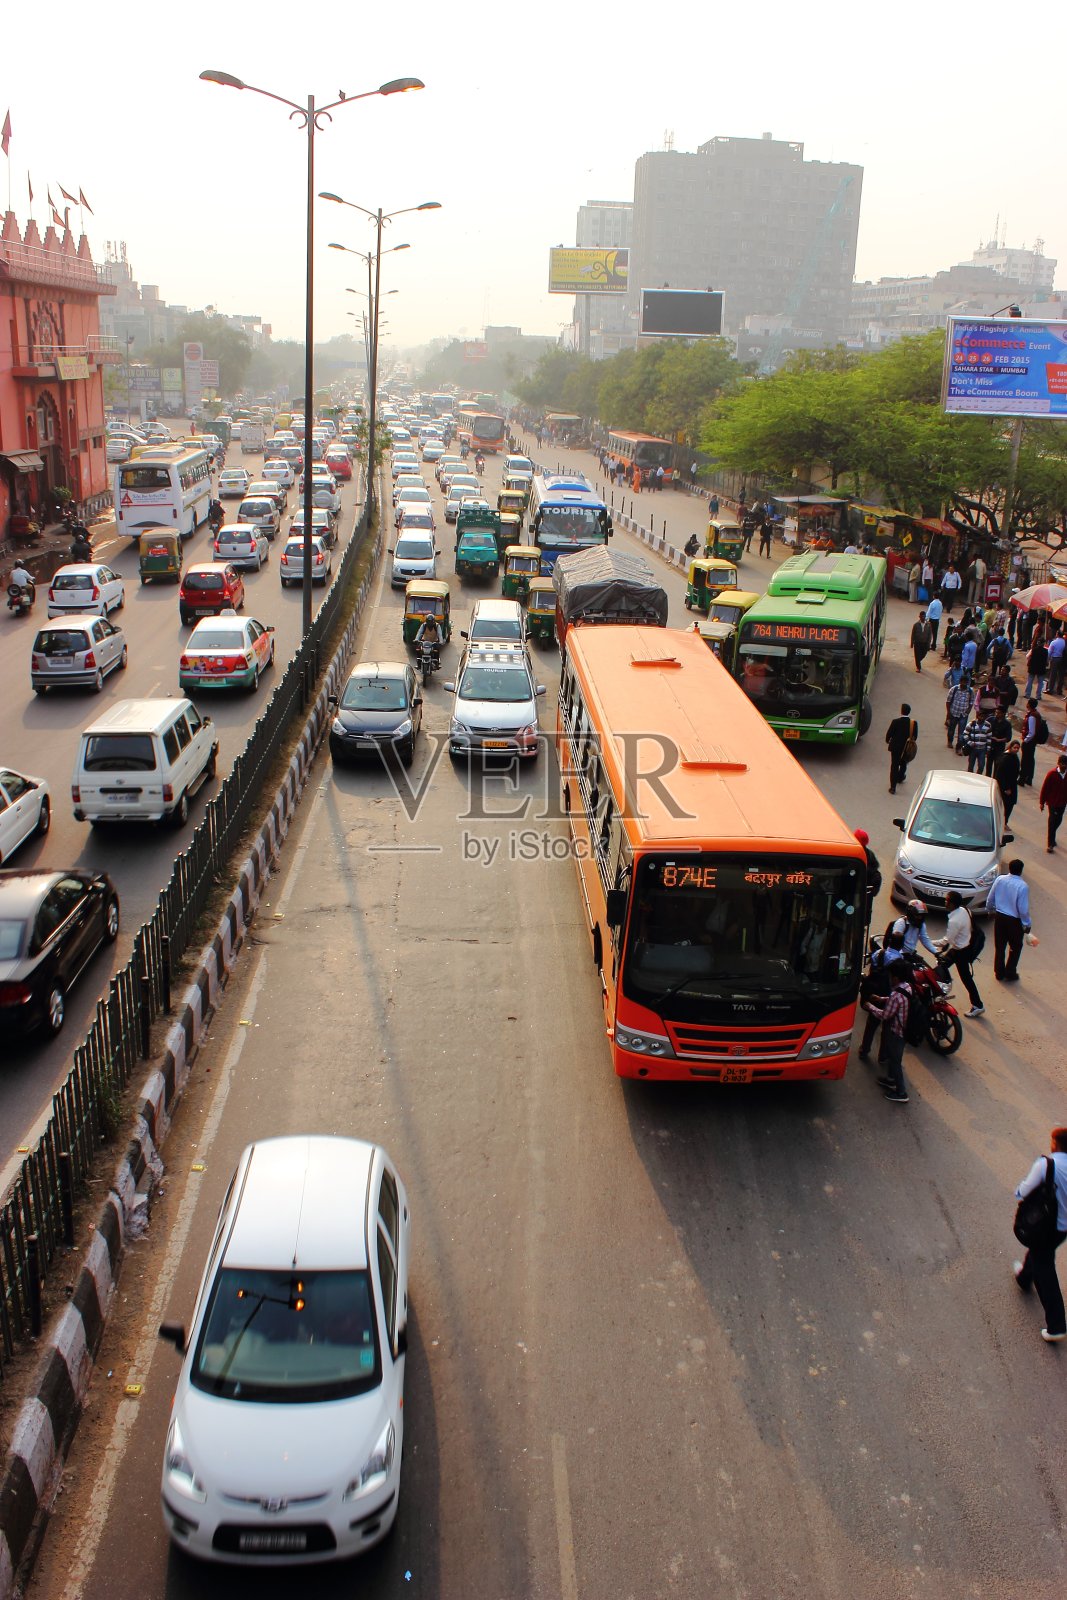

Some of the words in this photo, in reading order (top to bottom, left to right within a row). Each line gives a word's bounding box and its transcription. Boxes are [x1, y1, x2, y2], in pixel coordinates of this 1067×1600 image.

[955, 323, 978, 332] India's
[979, 324, 1008, 334] Flagship
[1019, 326, 1044, 334] Annual
[954, 336, 1027, 350] eCommerce
[1029, 342, 1051, 351] Event
[955, 354, 963, 362] 24
[969, 355, 977, 363] 25
[982, 355, 990, 363] 26
[994, 355, 1009, 363] FEB
[1011, 356, 1030, 364] 2015
[951, 377, 974, 385] Don't
[975, 377, 993, 386] Miss
[950, 387, 965, 395] The
[966, 387, 1014, 397] eCommerce
[1015, 389, 1039, 397] Boom
[542, 507, 602, 517] TOURIST
[753, 624, 772, 637] 764
[776, 625, 807, 639] NEHRU
[809, 627, 841, 641] PLACE
[663, 866, 718, 889] 874E
[731, 1003, 756, 1011] TATA
